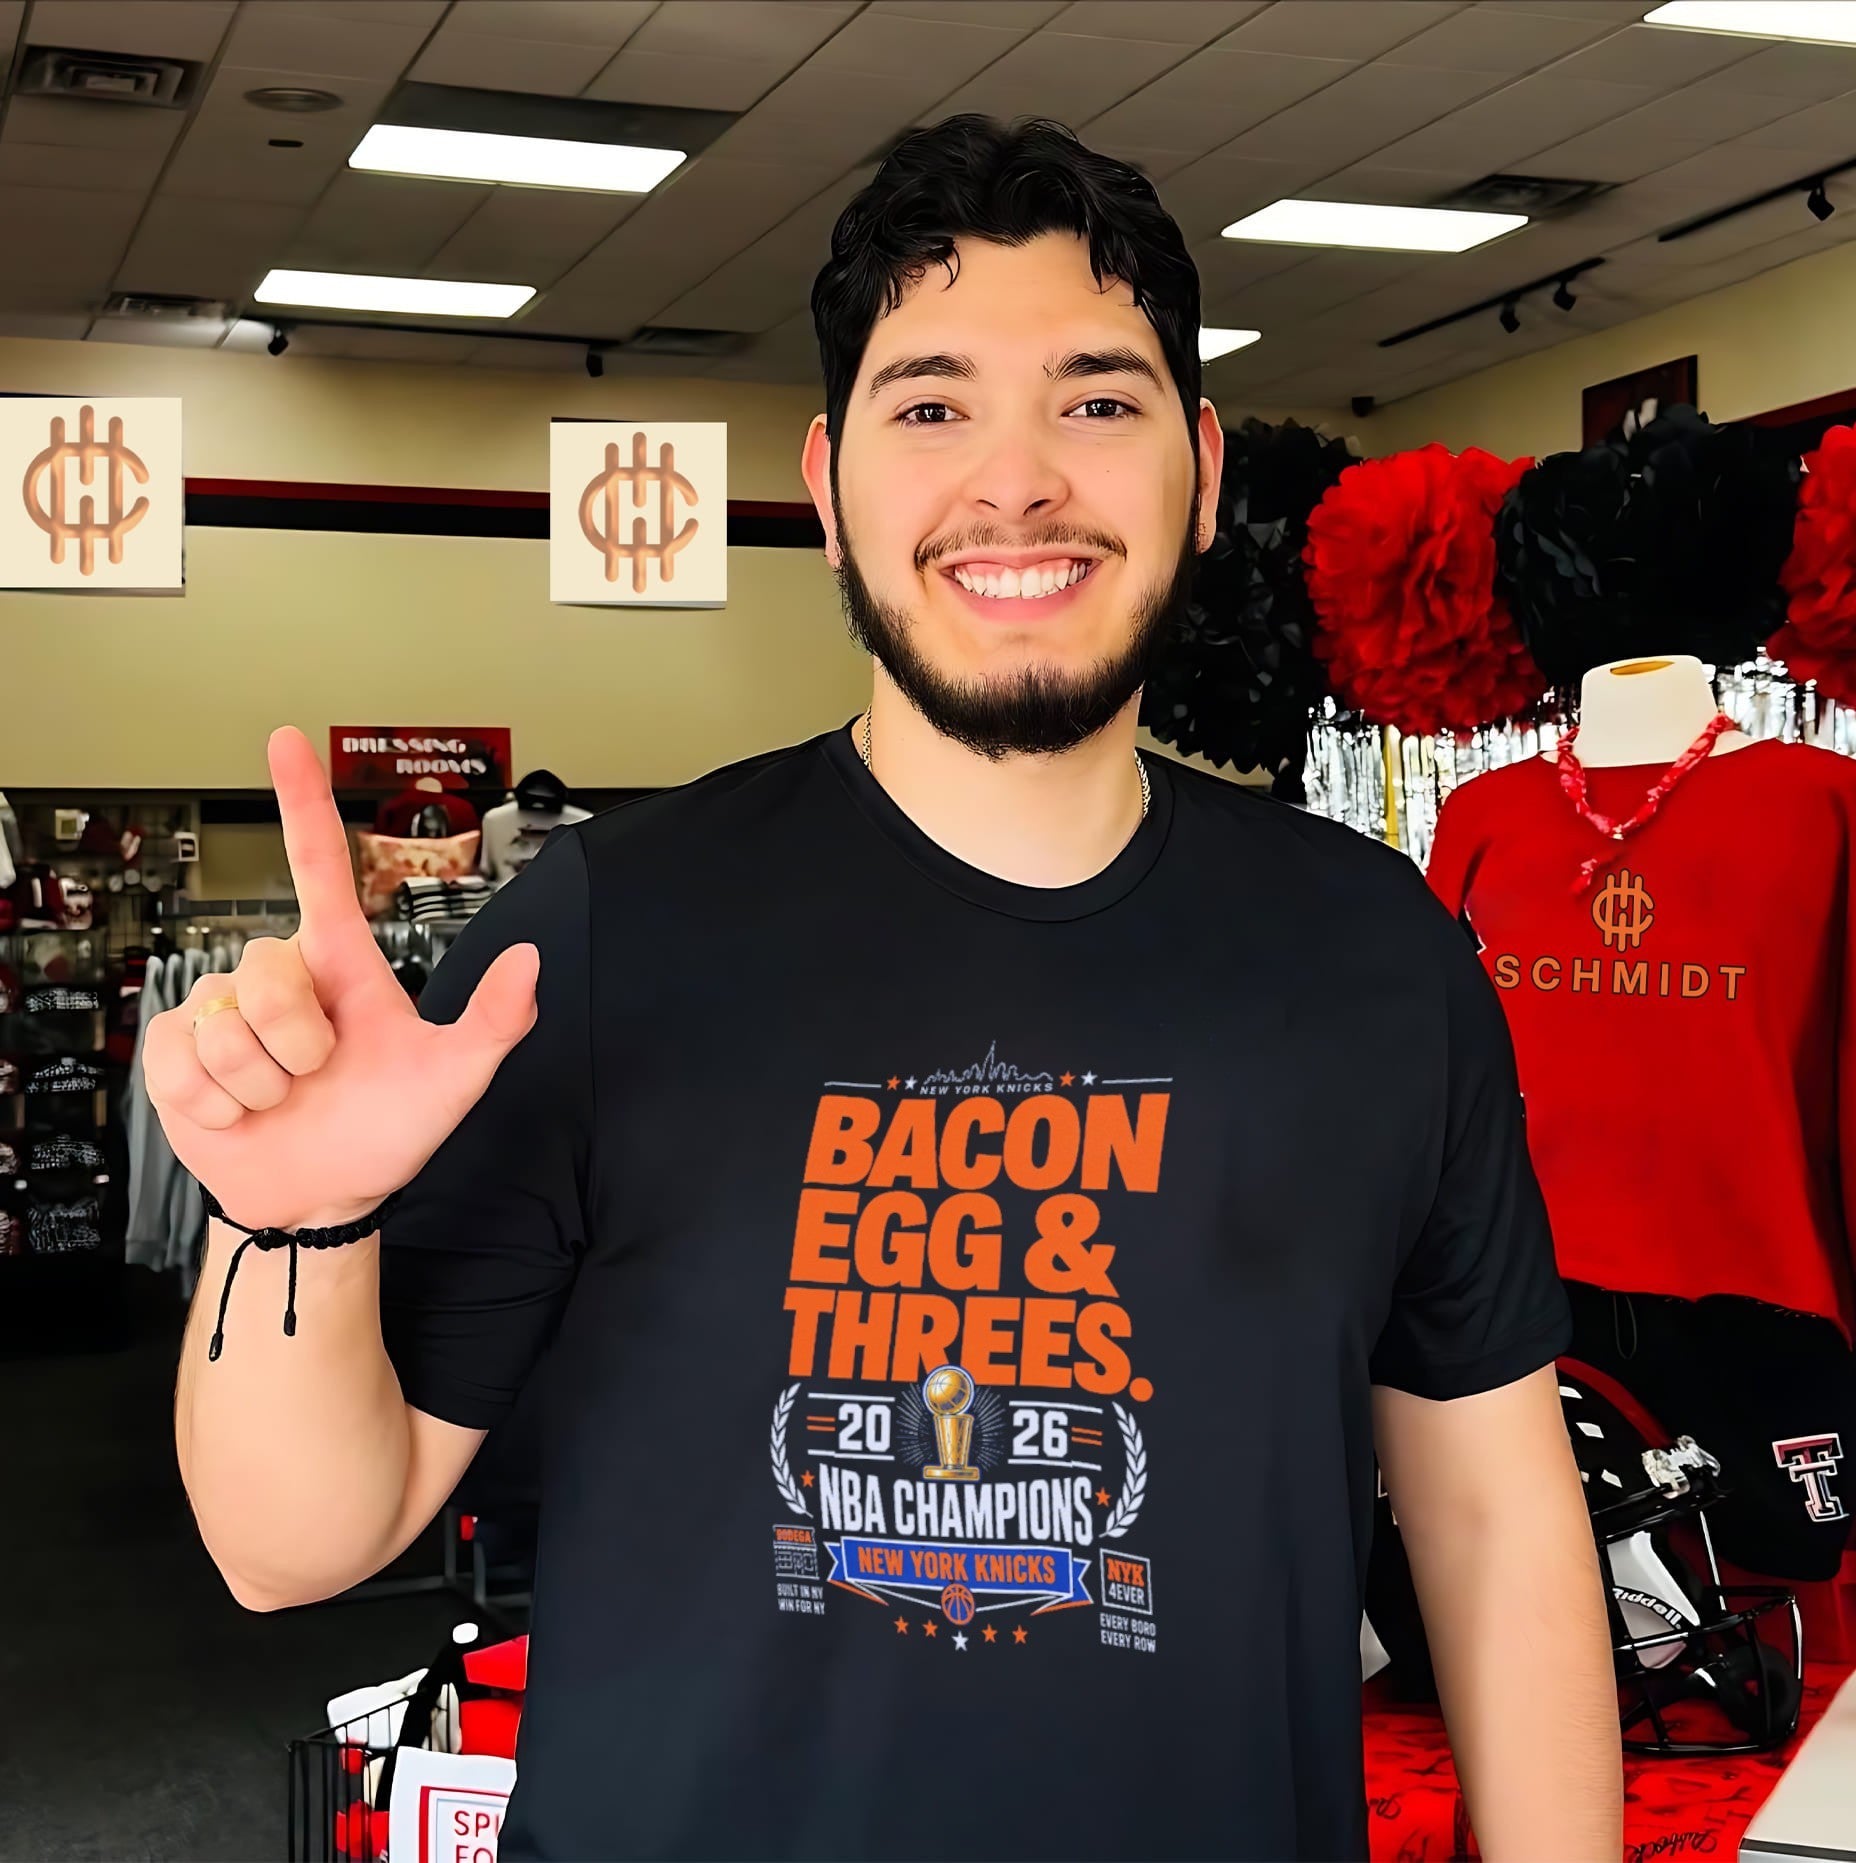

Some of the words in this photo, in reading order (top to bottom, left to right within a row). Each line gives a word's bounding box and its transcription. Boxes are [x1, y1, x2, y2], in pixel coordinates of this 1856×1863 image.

[396, 758, 487, 775] ROOMS
[1494, 954, 1747, 1000] SCHMIDT
[920, 1086, 949, 1095] NEW
[955, 1085, 990, 1094] YORK
[996, 1082, 1054, 1093] KNICKS
[802, 1093, 1171, 1194] BACON
[789, 1188, 1003, 1291] EGG
[1023, 1193, 1121, 1299] &
[783, 1287, 1154, 1403] THREES.
[838, 1403, 892, 1453] 20
[1012, 1409, 1069, 1459] 26
[819, 1462, 887, 1535] NBA
[893, 1476, 1093, 1547] CHAMPIONS
[776, 1529, 812, 1543] BODEGA
[857, 1546, 904, 1577] NEW
[910, 1549, 969, 1582] YORK
[974, 1553, 1057, 1585] KNICKS
[1107, 1558, 1145, 1587] NYK
[777, 1583, 798, 1597] BUILT
[800, 1584, 810, 1598] IN
[811, 1586, 823, 1600] NY
[1108, 1582, 1145, 1605] 4EVER
[778, 1597, 794, 1612] WIN
[796, 1599, 812, 1614] FOR
[814, 1601, 825, 1616] NY
[1100, 1613, 1128, 1631] EVERY
[1131, 1618, 1156, 1637] BORO
[1101, 1630, 1131, 1648] EVERY
[1133, 1635, 1156, 1653] ROW
